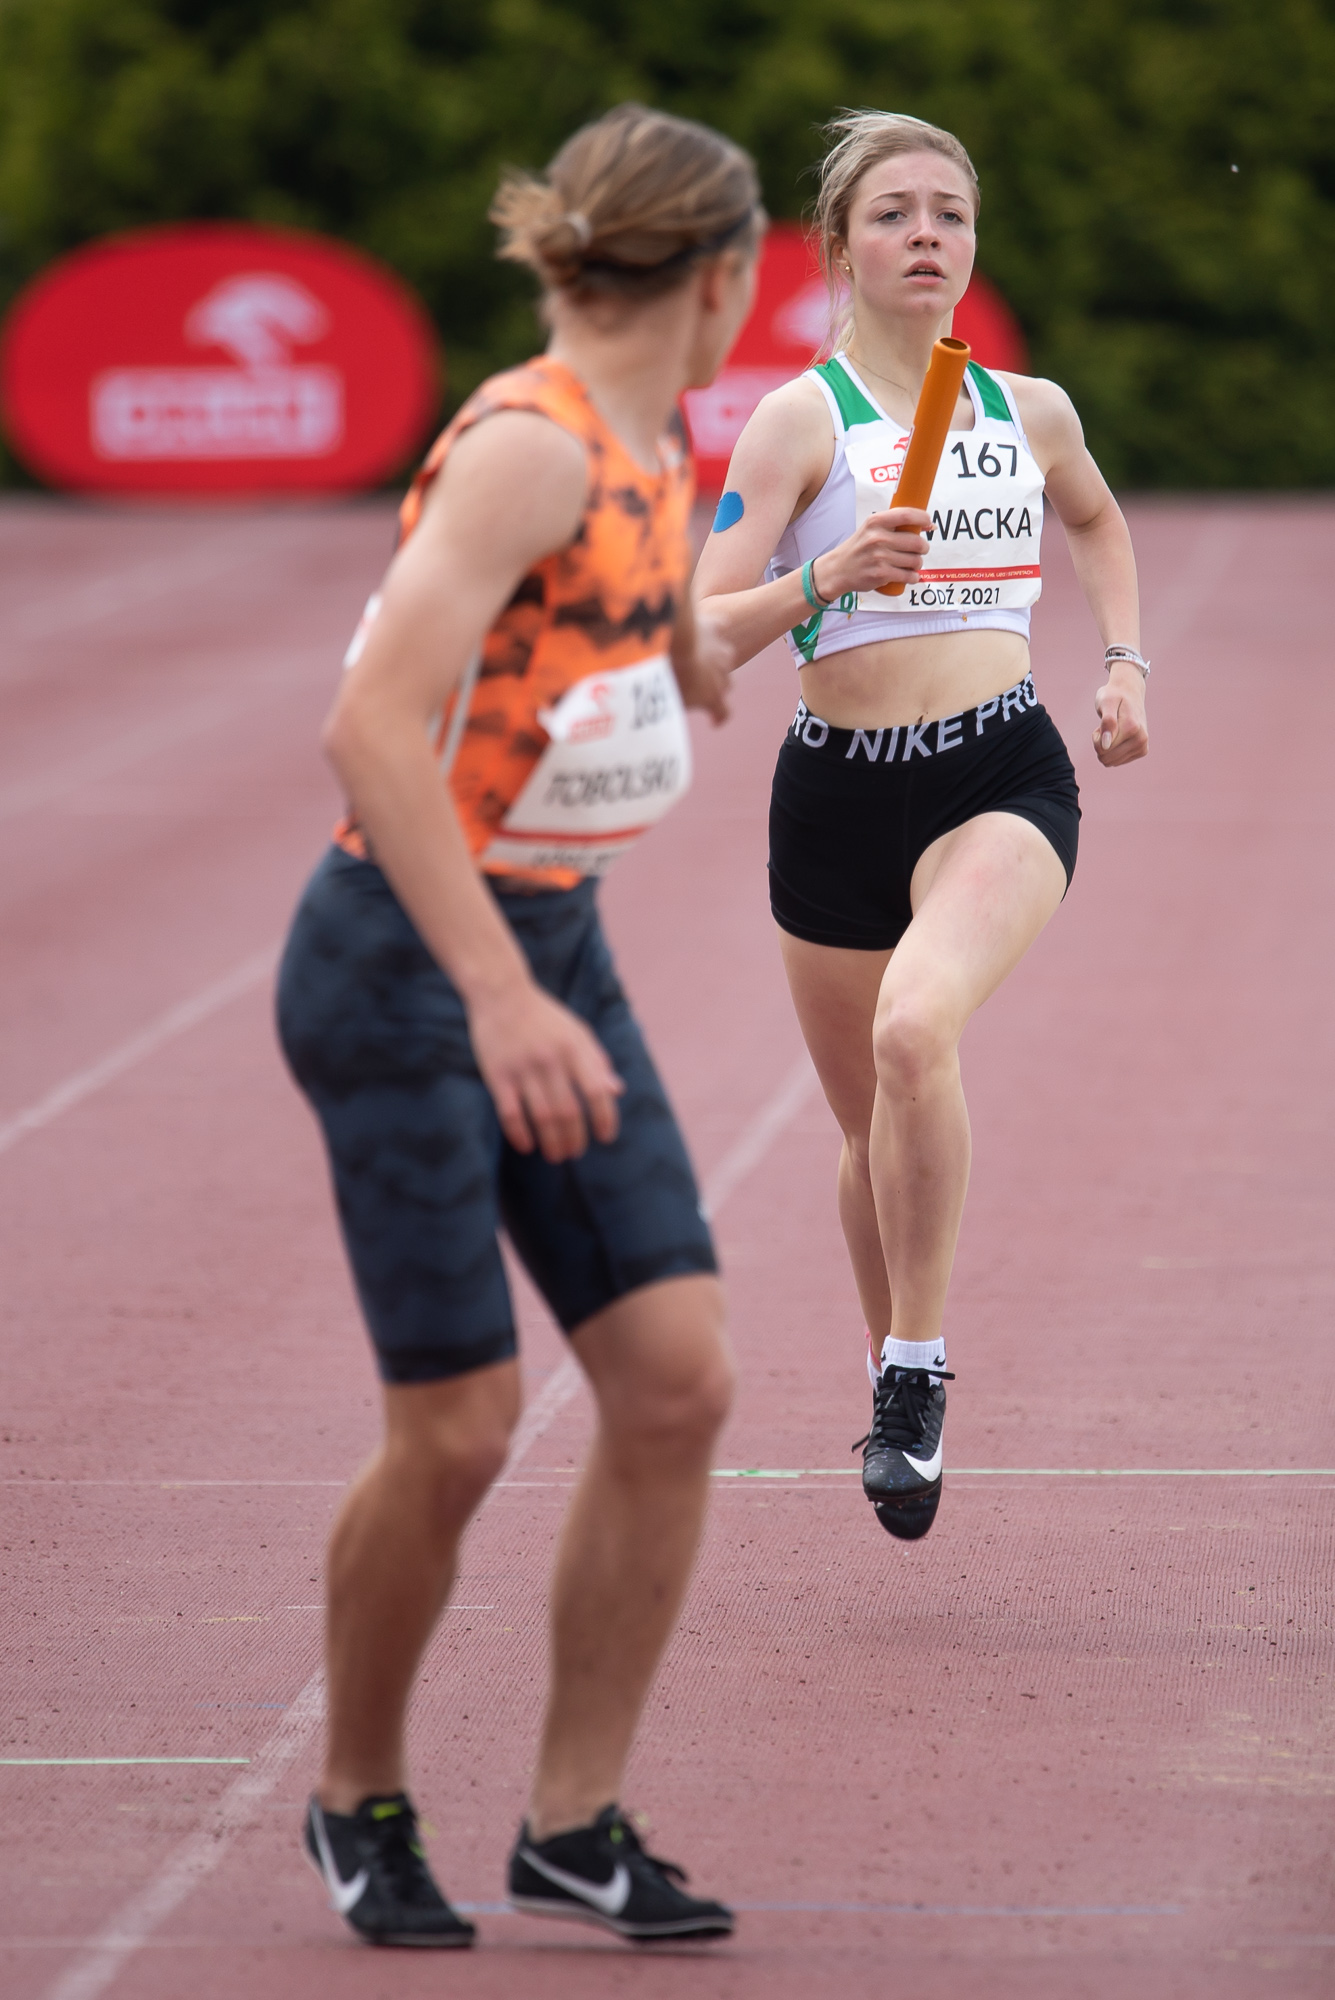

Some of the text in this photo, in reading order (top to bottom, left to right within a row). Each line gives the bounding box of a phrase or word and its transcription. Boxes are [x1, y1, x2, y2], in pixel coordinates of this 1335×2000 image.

[873, 464, 902, 483] OR
[950, 441, 1018, 479] 167
[925, 506, 1033, 542] WACKA
[909, 583, 1000, 607] ŁÓDŹ 2021
[845, 711, 964, 763] NIKE
[975, 671, 1039, 736] PRO
